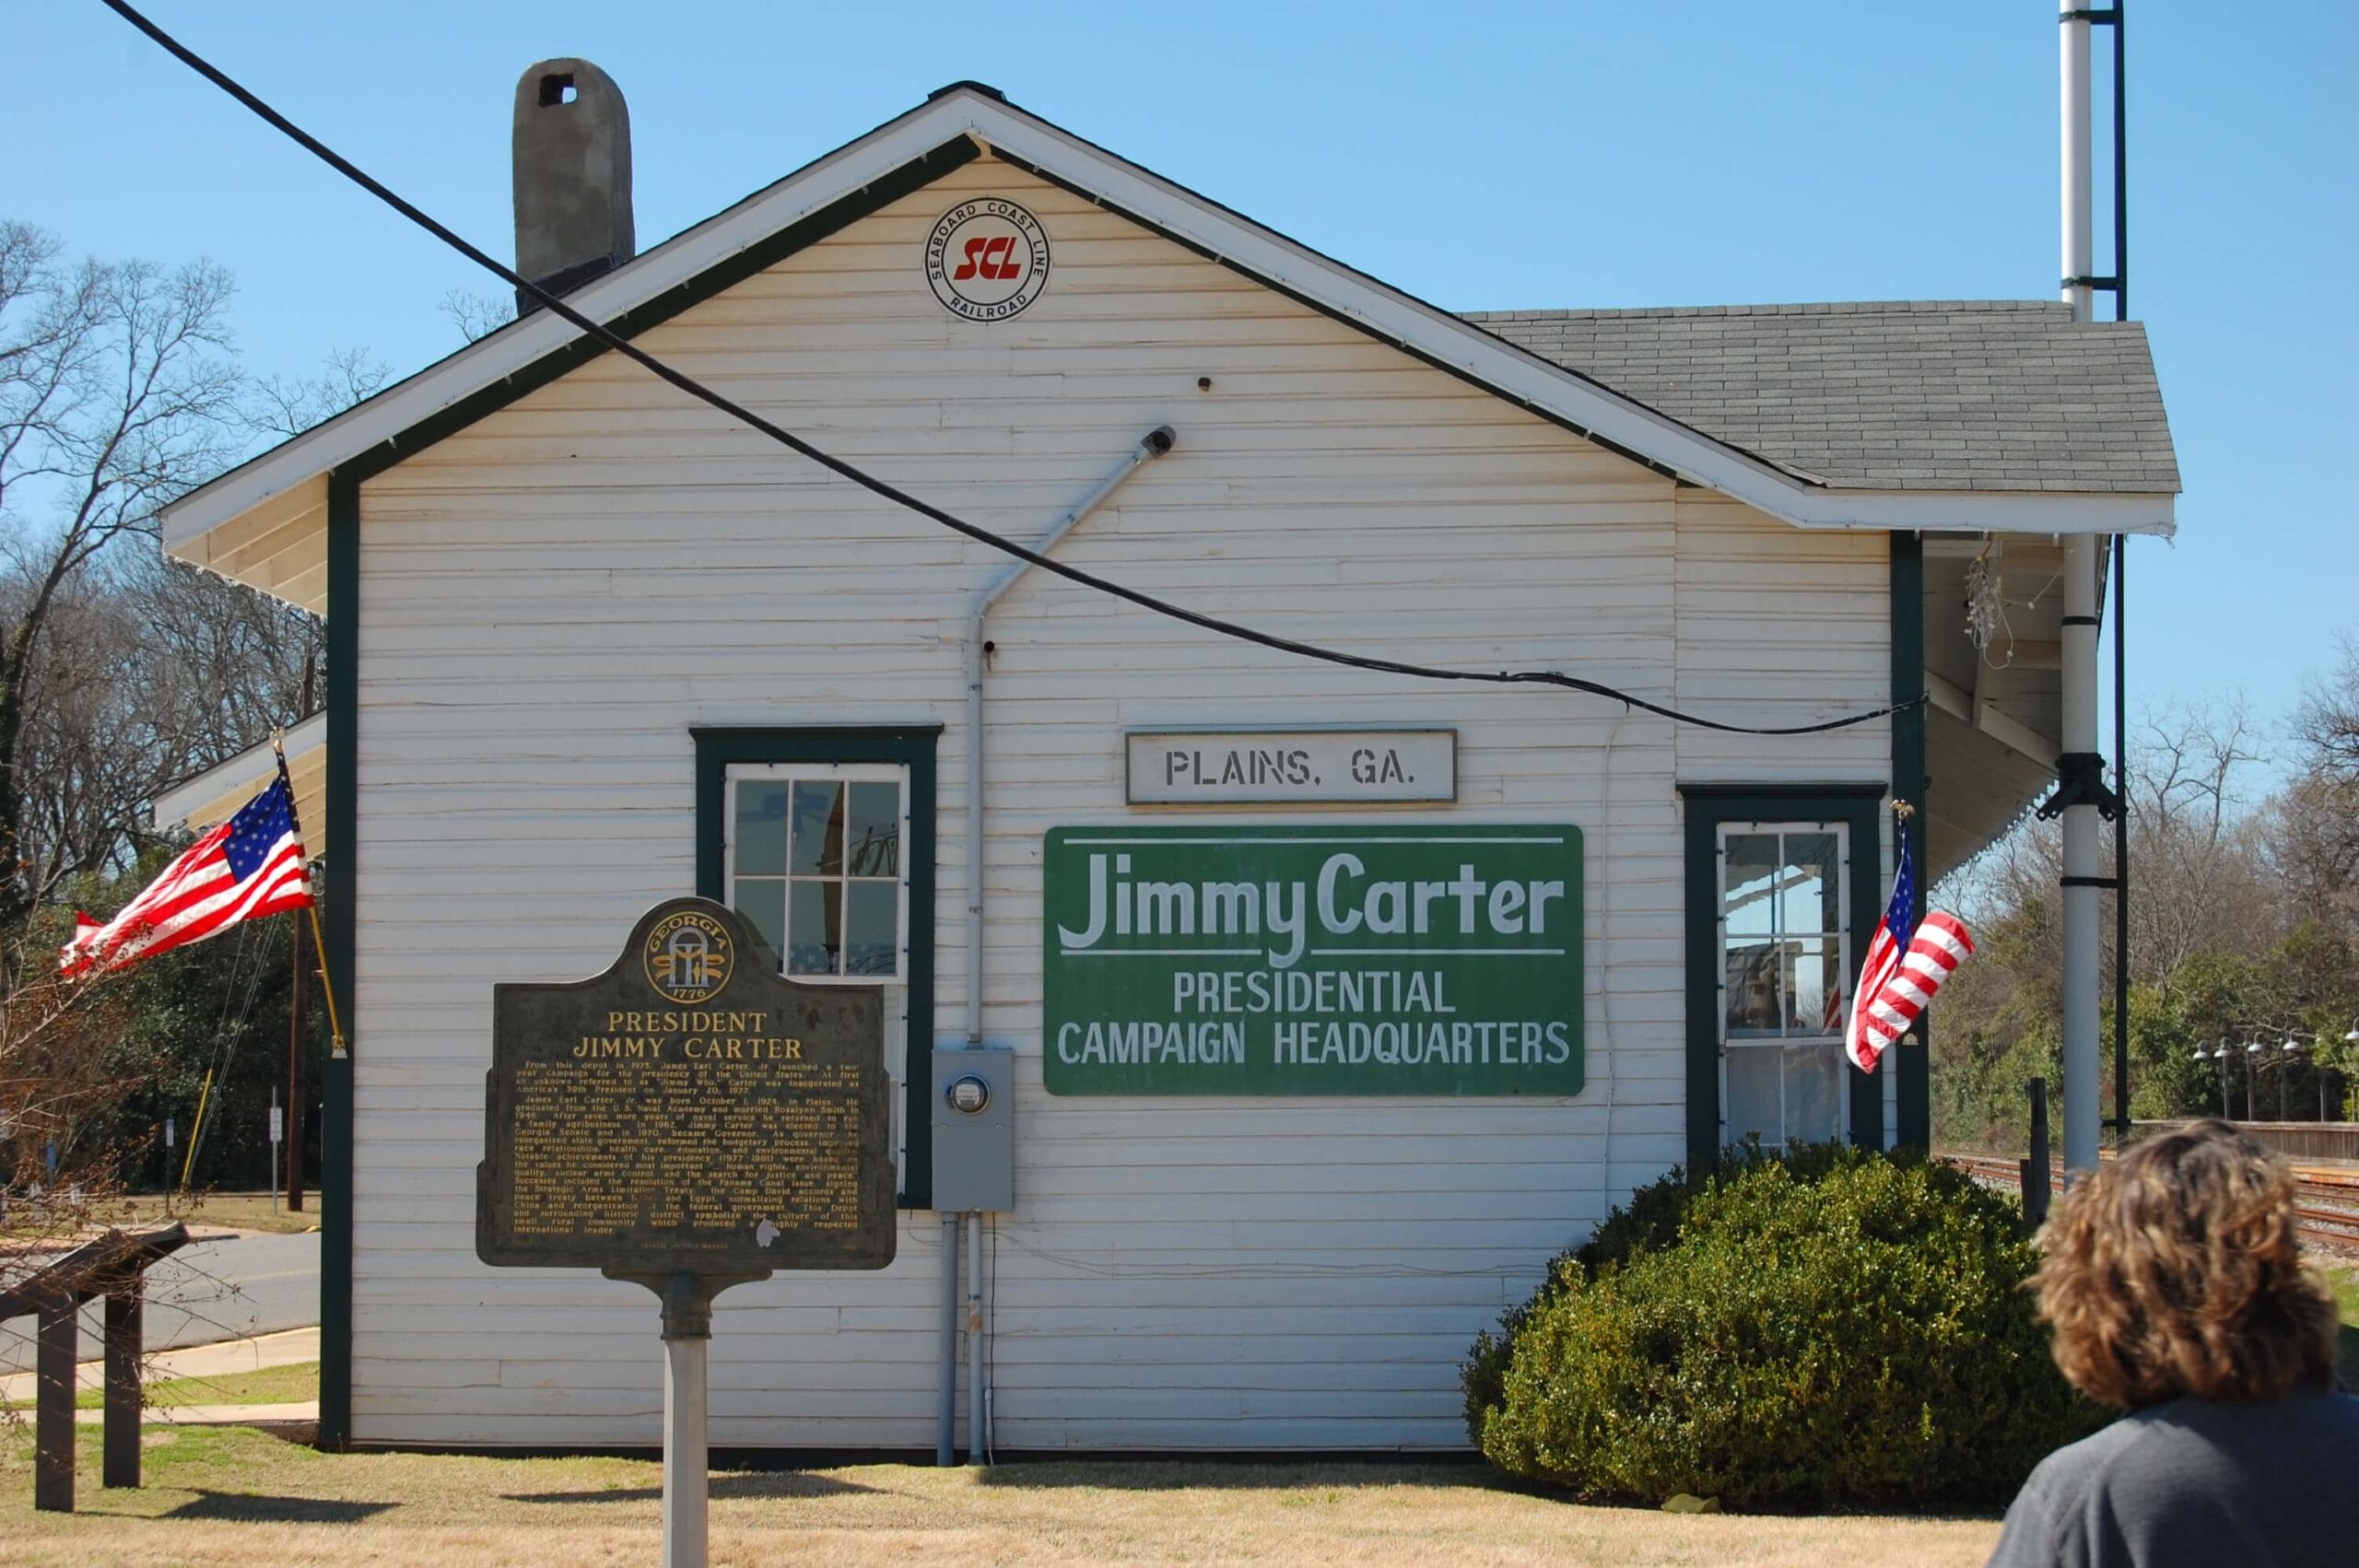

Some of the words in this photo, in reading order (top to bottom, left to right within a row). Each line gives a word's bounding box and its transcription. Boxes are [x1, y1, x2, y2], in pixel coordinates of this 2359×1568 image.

[930, 204, 977, 281] SEABOARD
[987, 202, 1036, 232] COAST
[1033, 240, 1045, 277] LINE
[953, 236, 1022, 281] SCL
[949, 294, 1027, 318] RAILROAD
[1165, 749, 1321, 787] PLAINS,
[1351, 748, 1416, 785] GA.
[1057, 853, 1306, 969] Jimmy
[1316, 852, 1565, 935] Carter
[649, 915, 728, 954] GEORGIA
[673, 988, 707, 999] 1776
[1173, 970, 1456, 1013] PRESIDENTIAL
[608, 1012, 768, 1033] PRESIDENT
[573, 1037, 666, 1059] JIMMY
[685, 1038, 802, 1059] CARTER
[1057, 1022, 1246, 1064] CAMPAIGN
[1273, 1020, 1570, 1065] HEADQUARTERS
[525, 1060, 547, 1069] From
[581, 1061, 607, 1071] depot
[694, 1062, 712, 1071] Earl
[778, 1063, 818, 1071] launched
[516, 1070, 537, 1078] year
[546, 1069, 588, 1078] campaign
[641, 1070, 690, 1079] presidency
[737, 1071, 767, 1079] United
[840, 1071, 859, 1080] first
[534, 1077, 572, 1085] unknown
[579, 1078, 616, 1086] referred
[728, 1079, 757, 1087] Carter
[788, 1080, 842, 1089] inaugurated
[566, 1085, 587, 1094] 39th
[663, 1086, 698, 1095] January
[524, 1095, 551, 1104] James
[558, 1095, 577, 1104] Earl
[670, 1096, 691, 1105] born
[699, 1097, 735, 1106] October
[515, 1104, 559, 1113] graduated
[566, 1104, 586, 1112] from
[638, 1105, 661, 1113] Naval
[667, 1105, 706, 1114] Academy
[734, 1106, 769, 1114] married
[775, 1106, 816, 1115] Rosalynn
[821, 1106, 845, 1115] Smith
[644, 1114, 668, 1122] years
[692, 1113, 717, 1121] naval
[723, 1113, 756, 1121] service
[781, 1114, 820, 1122] returned
[529, 1119, 557, 1129] family
[687, 1121, 717, 1130] Jimmy
[724, 1121, 753, 1129] Carter
[785, 1122, 818, 1130] elected
[515, 1128, 550, 1137] Georgia
[558, 1129, 590, 1137] Senate
[672, 1129, 707, 1138] became
[514, 1136, 567, 1145] reorganized
[722, 1138, 768, 1147] budgetary
[609, 1145, 638, 1153] health
[514, 1153, 548, 1161] Notable
[557, 1153, 616, 1161] achievements
[663, 1153, 710, 1163] presidency
[582, 1161, 629, 1169] considered
[661, 1162, 703, 1171] important
[555, 1169, 587, 1177] nuclear
[708, 1170, 738, 1178] search
[766, 1171, 796, 1180] justice
[514, 1176, 557, 1185] Successes
[630, 1177, 675, 1186] resolution
[720, 1178, 752, 1187] Panama
[826, 1179, 858, 1188] signing
[534, 1185, 575, 1194] Strategic
[733, 1187, 757, 1196] Camp
[765, 1187, 791, 1195] David
[797, 1188, 834, 1196] accords
[514, 1194, 540, 1202] peace
[548, 1193, 576, 1202] treaty
[728, 1195, 782, 1204] normalizing
[791, 1196, 830, 1204] relations
[839, 1196, 858, 1204] with
[573, 1201, 639, 1211] reorganization
[689, 1202, 722, 1211] federal
[803, 1203, 822, 1211] This
[831, 1204, 858, 1213] Depot
[539, 1210, 594, 1219] surrounding
[604, 1210, 639, 1218] historic
[650, 1211, 685, 1219] district
[695, 1211, 742, 1220] symbolize
[777, 1211, 809, 1220] culture
[514, 1217, 537, 1225] small
[587, 1218, 636, 1227] community
[693, 1219, 736, 1228] produced
[814, 1220, 858, 1229] respected
[514, 1225, 574, 1234] international
